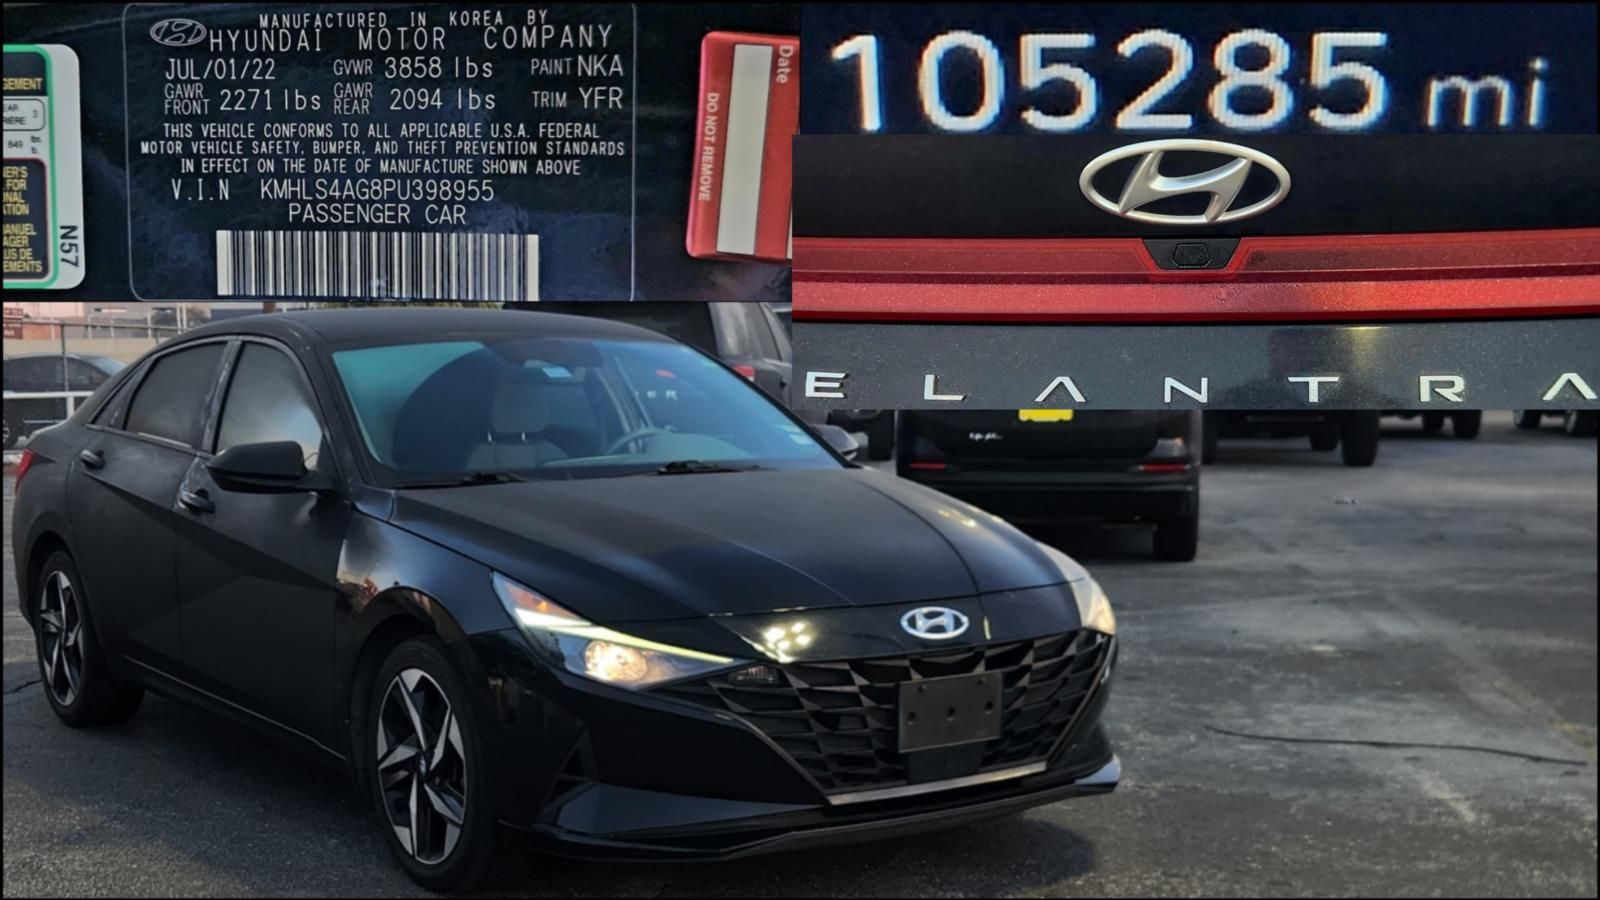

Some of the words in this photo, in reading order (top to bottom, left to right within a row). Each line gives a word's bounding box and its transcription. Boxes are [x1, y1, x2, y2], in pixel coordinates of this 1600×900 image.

[259, 12, 387, 28] MANUFACTURED
[410, 11, 427, 27] IN
[449, 10, 503, 26] KOREA
[527, 9, 548, 25] BY
[209, 29, 322, 51] HYUNDAI
[358, 26, 446, 51] MOTOR
[484, 24, 612, 49] COMPANY
[165, 58, 276, 80] JUL/01/22
[333, 59, 373, 76] GVWR
[384, 56, 442, 78] 3858
[531, 58, 572, 75] PAINT
[577, 54, 624, 77] NKA
[777, 45, 794, 83] Date
[830, 28, 1390, 134] 105285
[1423, 56, 1549, 129] mi
[164, 83, 204, 100] GAWR
[219, 88, 272, 111] 2271
[333, 82, 373, 99] GAWR
[389, 88, 443, 110] 2094
[532, 91, 567, 108] TRIM
[578, 87, 623, 110] YFR
[164, 99, 210, 115] FRONT
[333, 99, 370, 115] REAR
[707, 92, 719, 112] DO
[163, 123, 193, 138] THIS
[201, 123, 255, 138] VEHICLE
[263, 123, 333, 138] CONFORMS
[342, 123, 359, 138] TO
[367, 123, 391, 138] ALL
[400, 123, 482, 138] APPLICABLE
[490, 123, 531, 139] U.S.A.
[538, 123, 600, 139] FEDERAL
[704, 116, 718, 143] NOT
[140, 141, 183, 155] MOTOR
[191, 141, 244, 155] VEHICLE
[251, 142, 305, 157] SAFETY,
[313, 142, 366, 157] BUMPER,
[374, 142, 399, 155] AND
[407, 141, 446, 155] THEFT
[455, 141, 538, 156] PREVENTION
[545, 141, 625, 156] STANDARDS
[181, 158, 194, 174] IN
[201, 158, 249, 174] EFFECT
[257, 158, 275, 174] ON
[282, 158, 306, 174] THE
[313, 158, 347, 174] DATE
[355, 158, 372, 174] OF
[379, 158, 474, 175] MANUFACTURE
[482, 159, 528, 175] SHOWN
[535, 159, 582, 176] ABOVE
[699, 146, 714, 201] REMOVE
[260, 178, 494, 201] KMHLS4AG8PU398955
[288, 203, 411, 224] PASSENGER
[424, 204, 467, 225] CAR
[60, 225, 79, 267] N57
[805, 371, 1598, 404] ELANTRA
